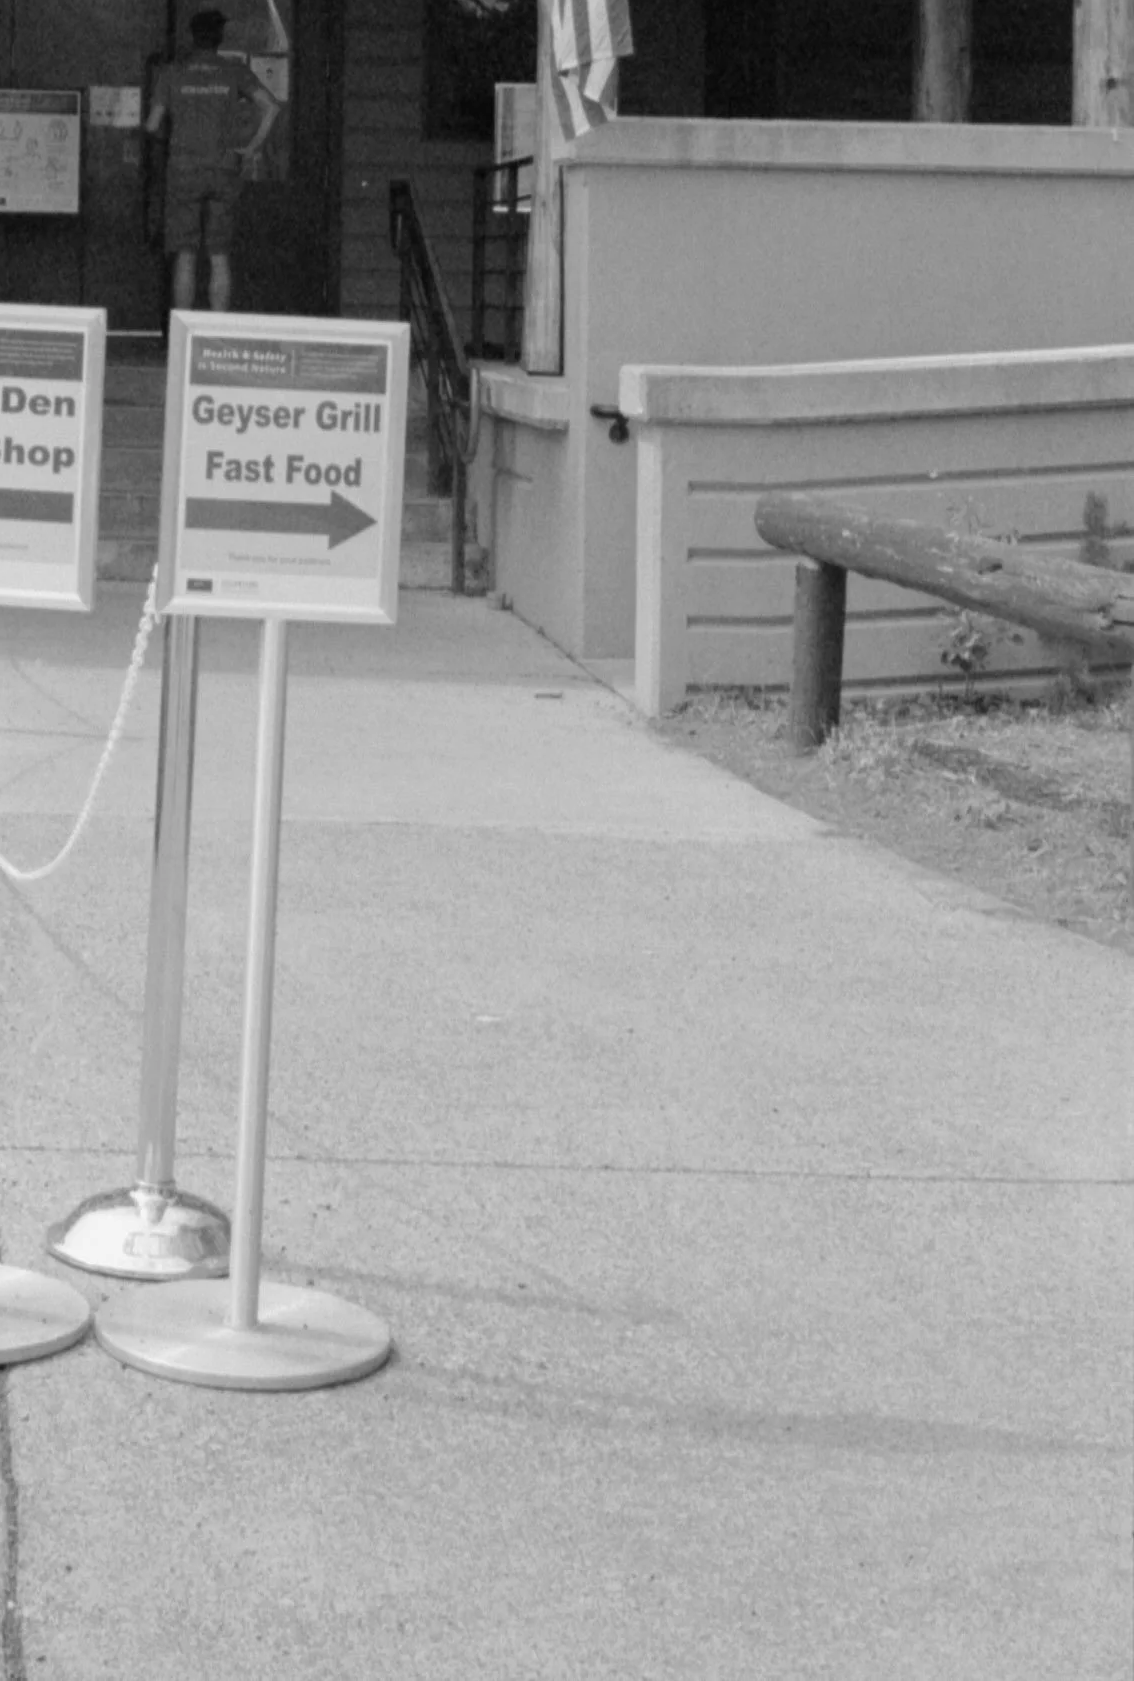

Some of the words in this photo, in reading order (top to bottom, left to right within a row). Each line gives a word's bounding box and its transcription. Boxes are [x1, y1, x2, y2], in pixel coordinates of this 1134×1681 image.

[253, 350, 287, 362] Safety
[1, 385, 75, 417] Den
[191, 394, 306, 434] Geyser
[315, 400, 381, 433] Grill
[205, 450, 275, 483] Fast
[286, 454, 362, 487] Food
